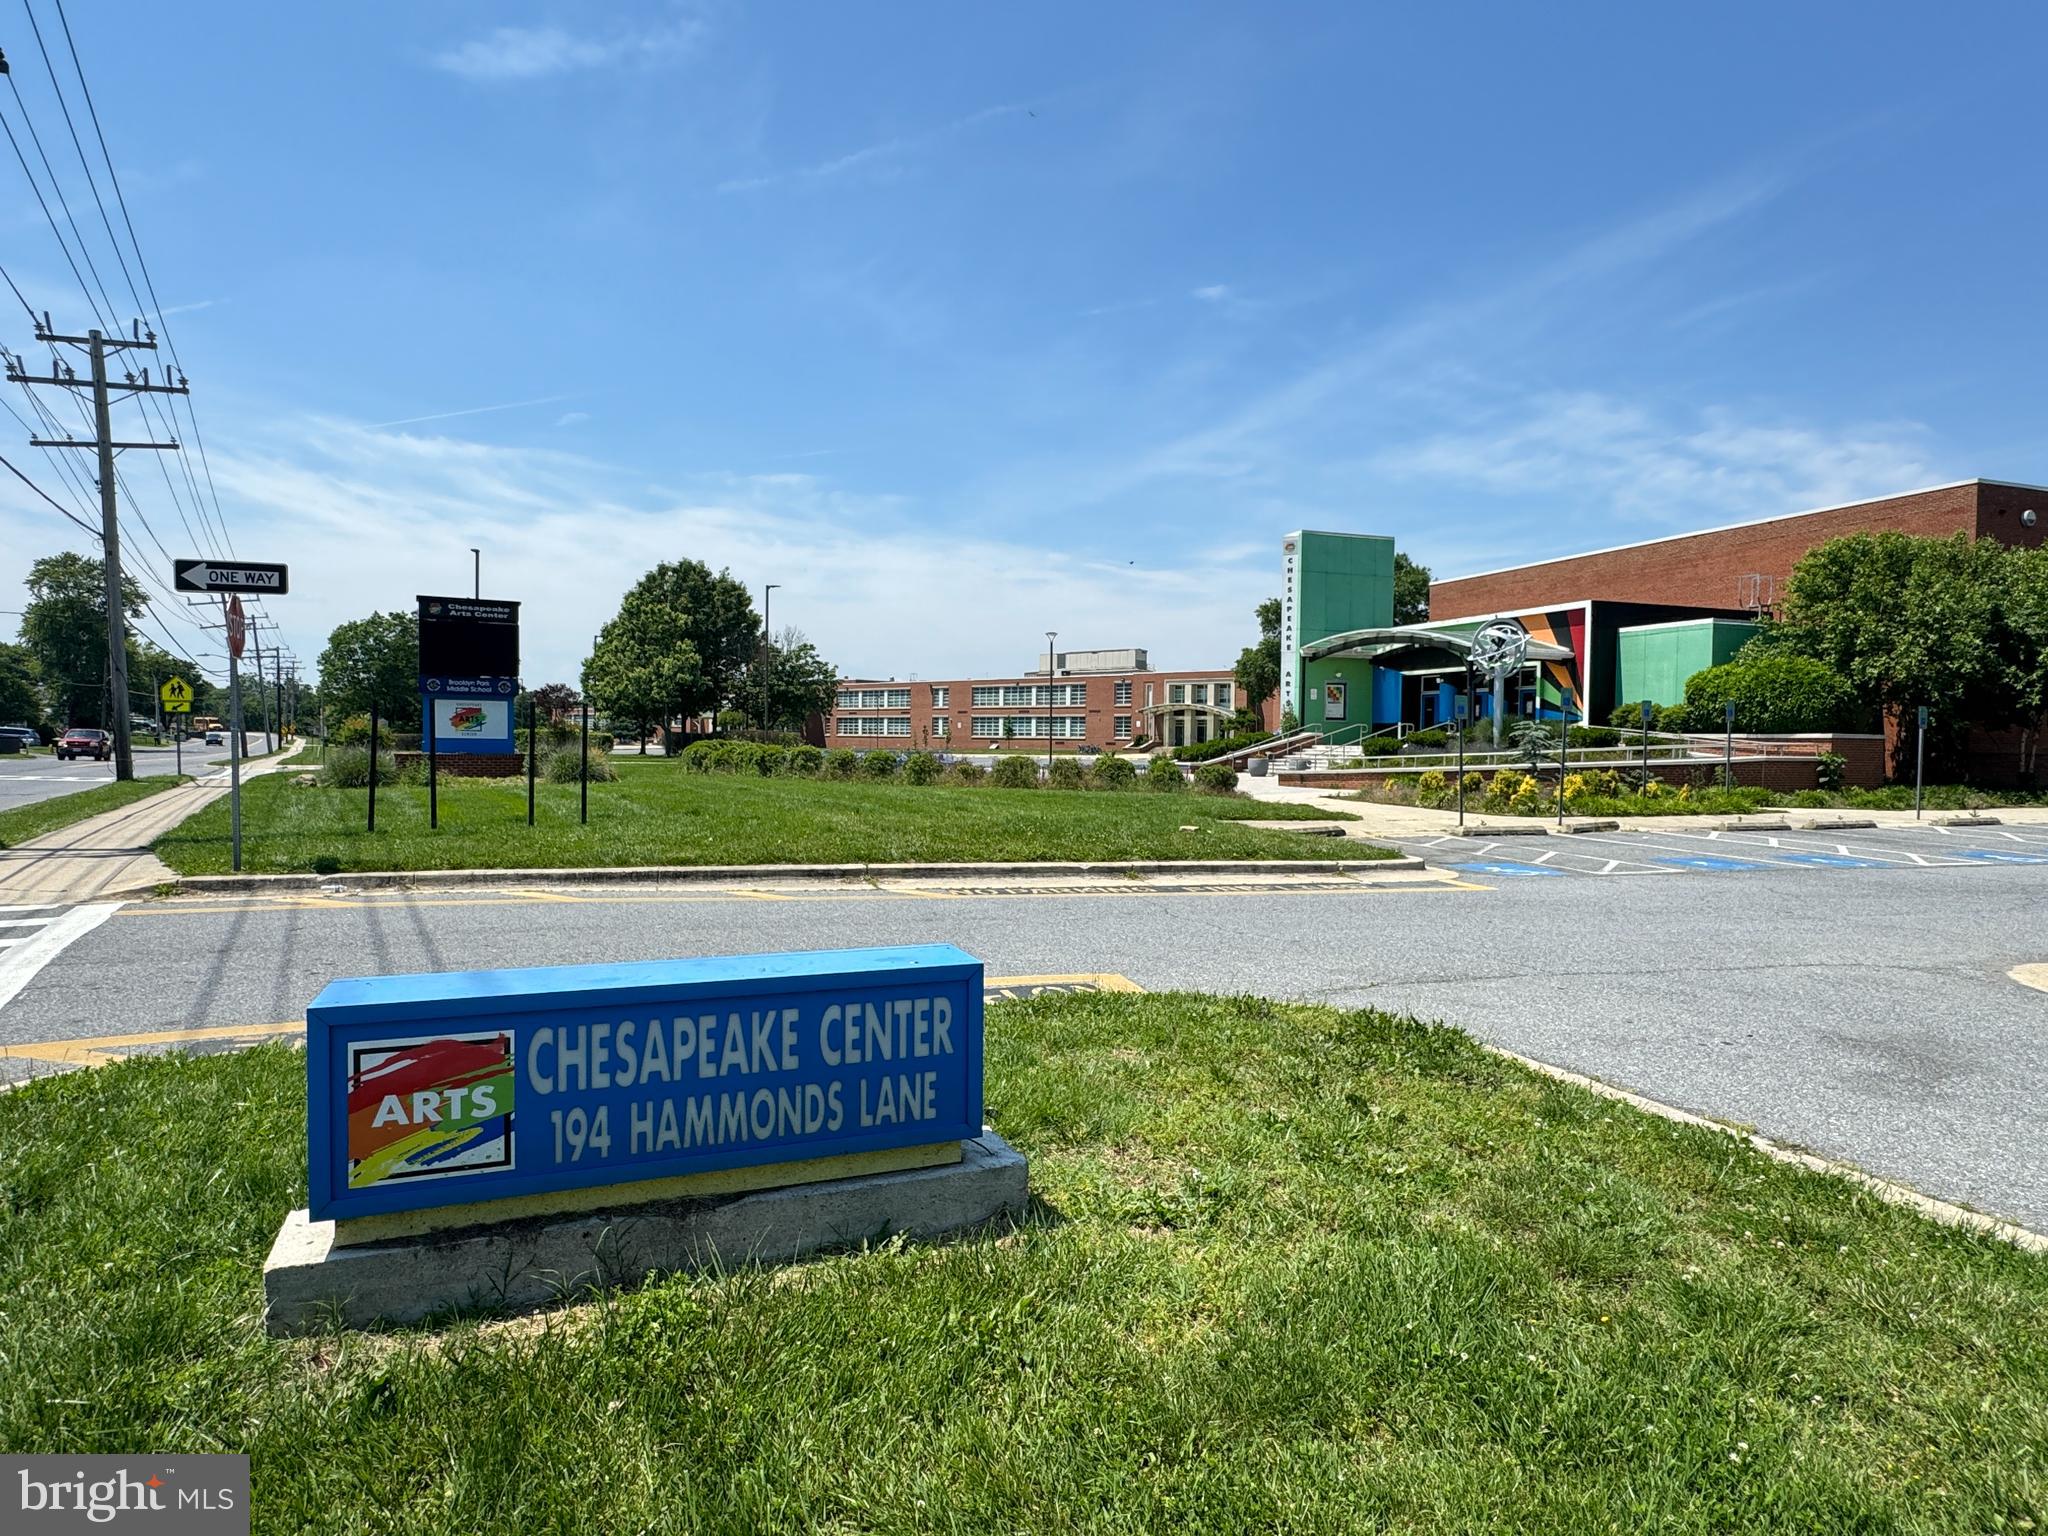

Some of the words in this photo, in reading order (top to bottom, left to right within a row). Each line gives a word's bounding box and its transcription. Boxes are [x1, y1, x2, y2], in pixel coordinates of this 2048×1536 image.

[209, 570, 239, 583] ONE
[244, 572, 275, 585] WAY
[448, 603, 511, 613] Chesapeake
[474, 611, 509, 619] Center
[1286, 557, 1294, 651] CHESAPEAKE
[229, 612, 244, 640] STOP
[448, 679, 476, 687] Brooklyn
[527, 1007, 799, 1095] CHESAPEAKE
[819, 997, 954, 1067] CENTER
[371, 1085, 497, 1128] ARTS
[551, 1105, 611, 1163] 194
[630, 1080, 843, 1154] HAMMONDS
[860, 1071, 937, 1127] LANE
